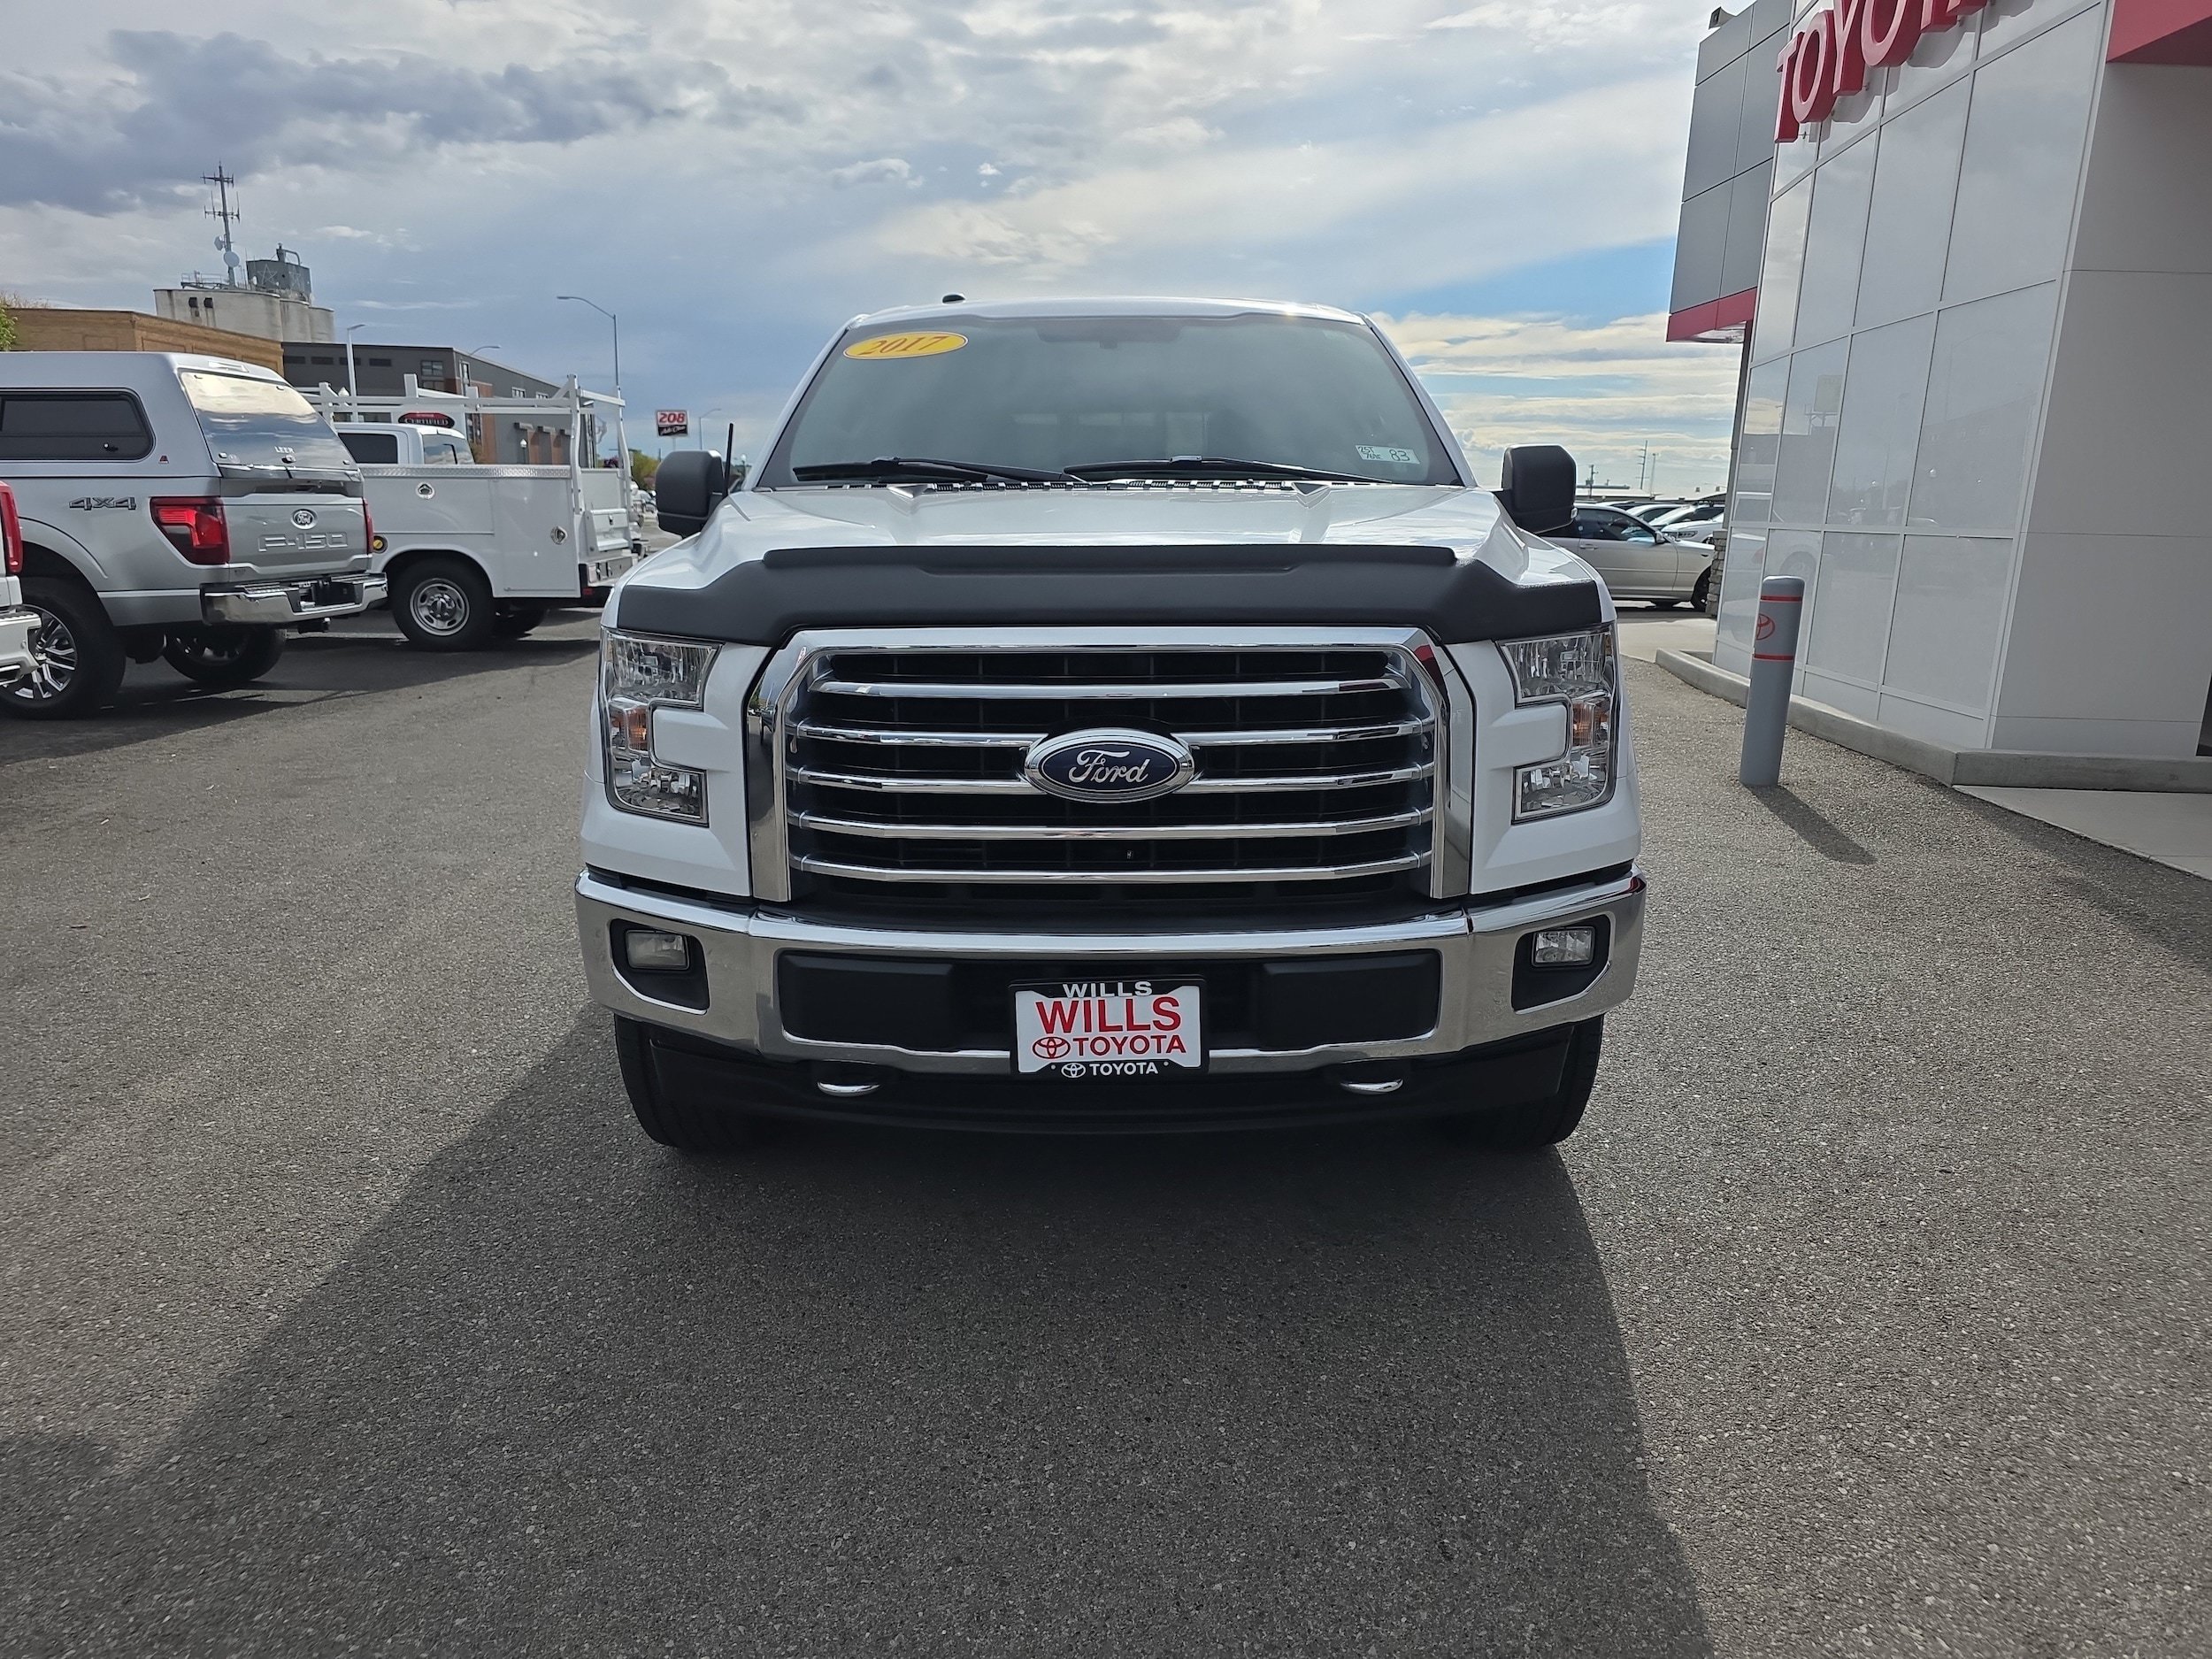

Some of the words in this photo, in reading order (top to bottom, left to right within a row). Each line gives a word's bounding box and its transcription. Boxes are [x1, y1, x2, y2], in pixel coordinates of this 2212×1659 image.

[856, 335, 949, 356] 2017
[659, 412, 685, 424] 208
[273, 445, 295, 454] LEER
[1389, 449, 1410, 461] 83
[296, 512, 312, 525] Ford
[258, 532, 348, 552] F-150
[1068, 749, 1150, 783] Ford
[1063, 980, 1152, 998] WILLS
[1035, 996, 1182, 1034] WILLS
[1072, 1034, 1187, 1056] TOYOTA
[1089, 1062, 1158, 1076] TOYOTA
